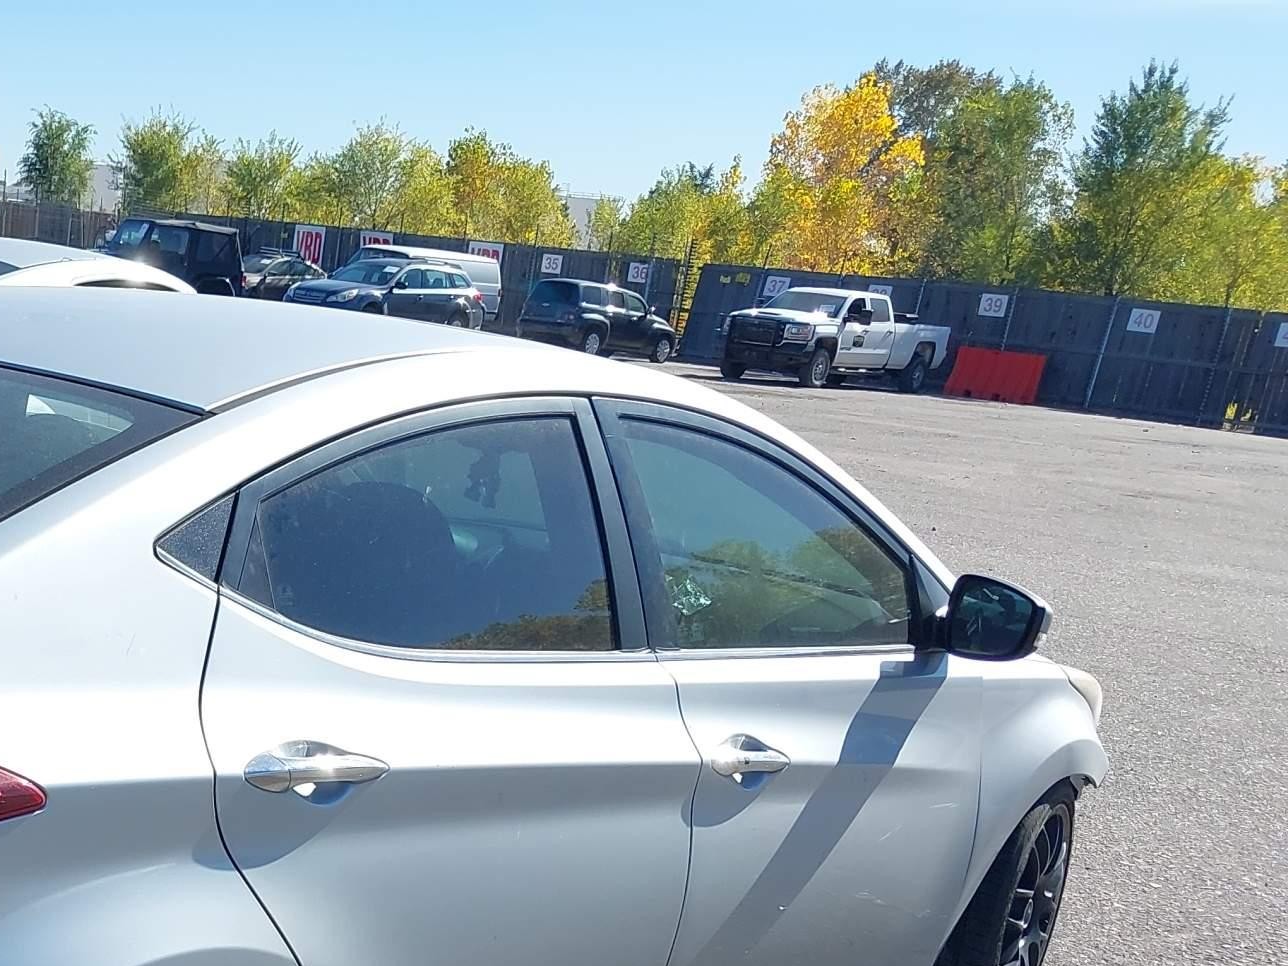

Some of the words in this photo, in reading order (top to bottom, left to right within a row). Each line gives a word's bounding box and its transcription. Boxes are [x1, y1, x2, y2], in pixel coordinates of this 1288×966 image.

[544, 256, 559, 271] 35
[632, 266, 648, 280] 36
[768, 279, 786, 293] 37
[983, 297, 1003, 313] 39
[1133, 312, 1155, 329] 40
